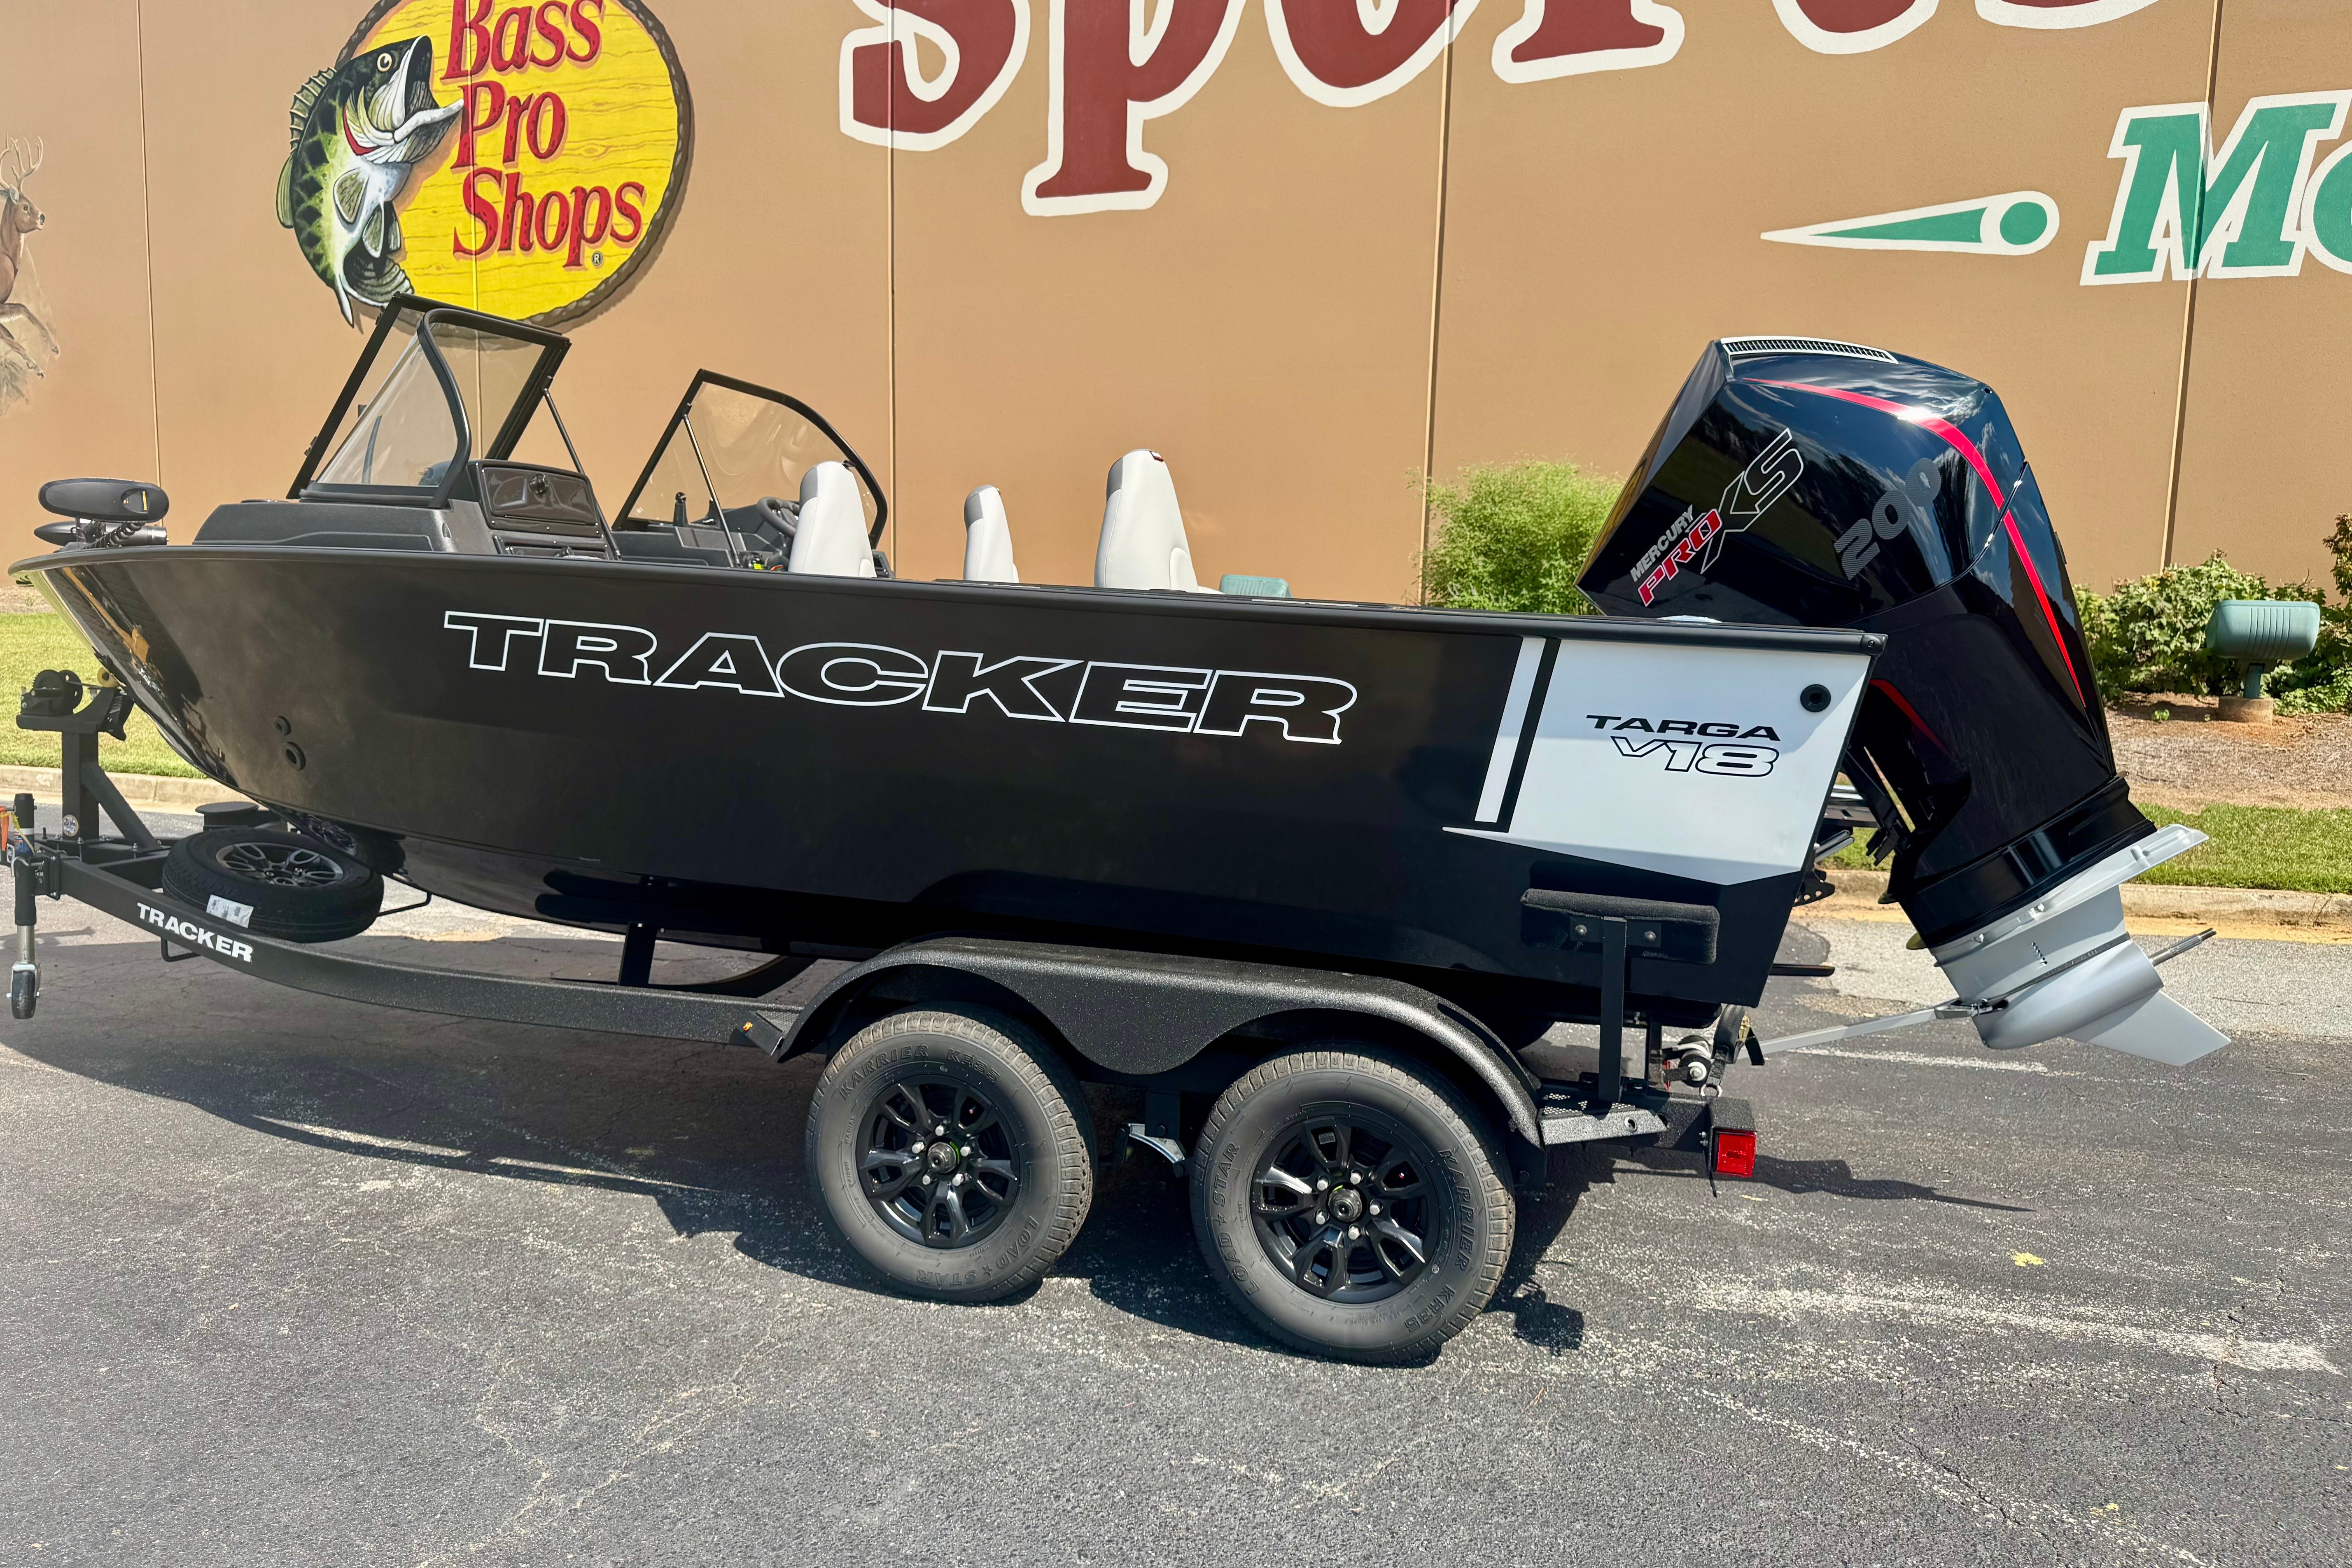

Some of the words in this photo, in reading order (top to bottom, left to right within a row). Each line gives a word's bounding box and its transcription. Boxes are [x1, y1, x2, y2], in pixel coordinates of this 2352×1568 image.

[440, 0, 604, 81] Bass
[450, 80, 564, 169] Pro
[453, 167, 645, 268] Shops
[1630, 504, 1693, 582] MERCURY
[1638, 508, 1723, 607] PRO
[444, 610, 1357, 744] TRACKER
[1586, 714, 1781, 742] TARGA
[1610, 735, 1779, 777] V18
[137, 902, 254, 964] TRACKER
[839, 1044, 929, 1101] KARRIER
[947, 1048, 1001, 1083] KR35
[1213, 1142, 1241, 1207] STAR
[996, 1215, 1039, 1269] LOAD
[1218, 1232, 1261, 1295] LOAD
[917, 1269, 977, 1286] STAR
